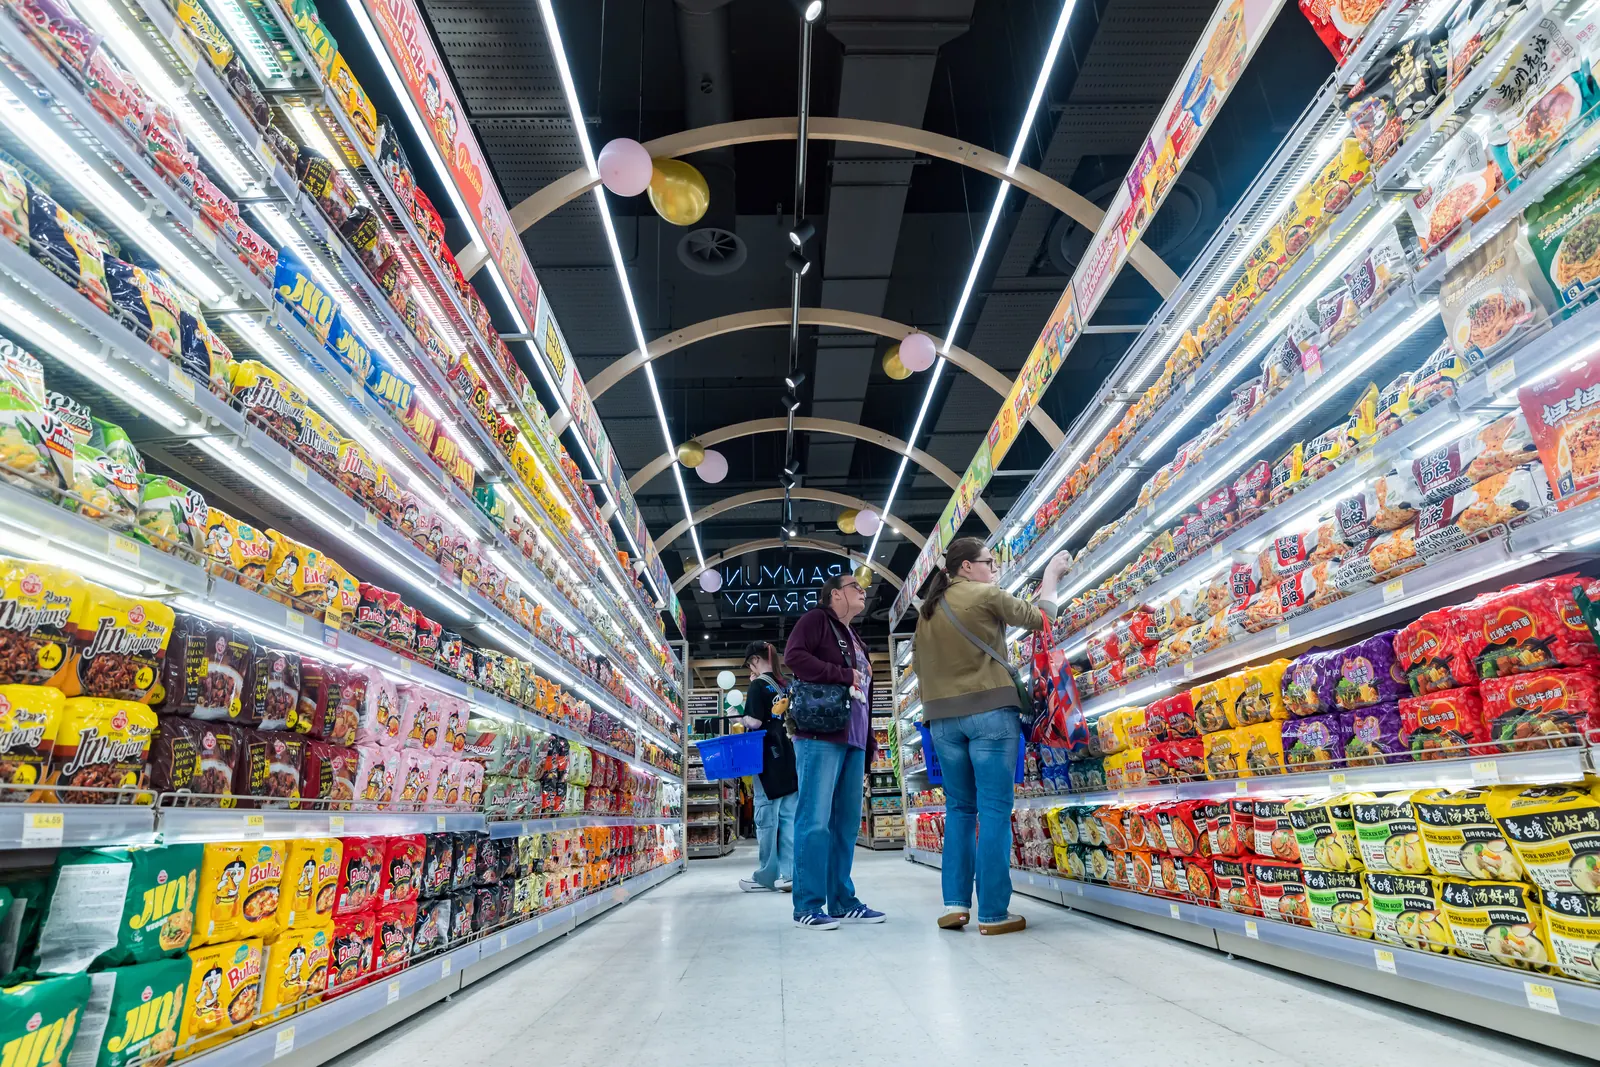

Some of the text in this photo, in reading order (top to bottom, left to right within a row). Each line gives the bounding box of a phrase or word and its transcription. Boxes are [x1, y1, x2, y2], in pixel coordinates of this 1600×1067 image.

[1080, 237, 1105, 294] NOODLE
[1304, 355, 1319, 367] SELLER
[1305, 349, 1316, 360] BEST
[1470, 352, 1477, 362] 8
[243, 375, 280, 410] Jin
[1542, 383, 1600, 427] 担担
[53, 433, 74, 450] NOOD
[1436, 476, 1472, 496] Noodle
[1562, 477, 1571, 491] 8
[1430, 526, 1461, 544] Noodle
[1293, 561, 1314, 572] Noodle
[14, 604, 71, 632] Jjajang
[82, 615, 126, 660] Jin
[123, 632, 163, 655] Jjajang
[1488, 615, 1531, 641] 红烧牛肉面
[1410, 637, 1438, 661] 红烧牛肉面
[1514, 687, 1563, 707] 红烧牛肉面
[1421, 707, 1456, 726] 红烧牛肉面
[62, 727, 108, 777] Jin
[1364, 812, 1379, 822] 白象
[1380, 803, 1414, 818] 汤好喝
[1431, 808, 1447, 825] 白象
[1448, 804, 1494, 824] 汤好喝
[1523, 818, 1549, 839] 白象
[1547, 810, 1600, 834] 汤好喝
[1522, 849, 1571, 860] PORK BONE SOUP
[248, 862, 282, 887] Buldak
[350, 866, 370, 885] Bulda
[393, 864, 413, 881] Bulda
[1275, 867, 1299, 882] 汤好喝
[1328, 873, 1357, 888] 汤好喝
[1312, 877, 1327, 889] 白象
[1376, 880, 1394, 894] 白象
[1394, 877, 1429, 896] 汤好喝
[1455, 889, 1473, 906] 白象
[1474, 887, 1519, 907] 汤好喝
[1559, 895, 1587, 914] 白象
[1448, 914, 1462, 923] PORK
[1551, 921, 1567, 931] PORK
[1567, 926, 1585, 935] BONE
[384, 928, 405, 947] Bulda
[338, 943, 363, 965] Bulda
